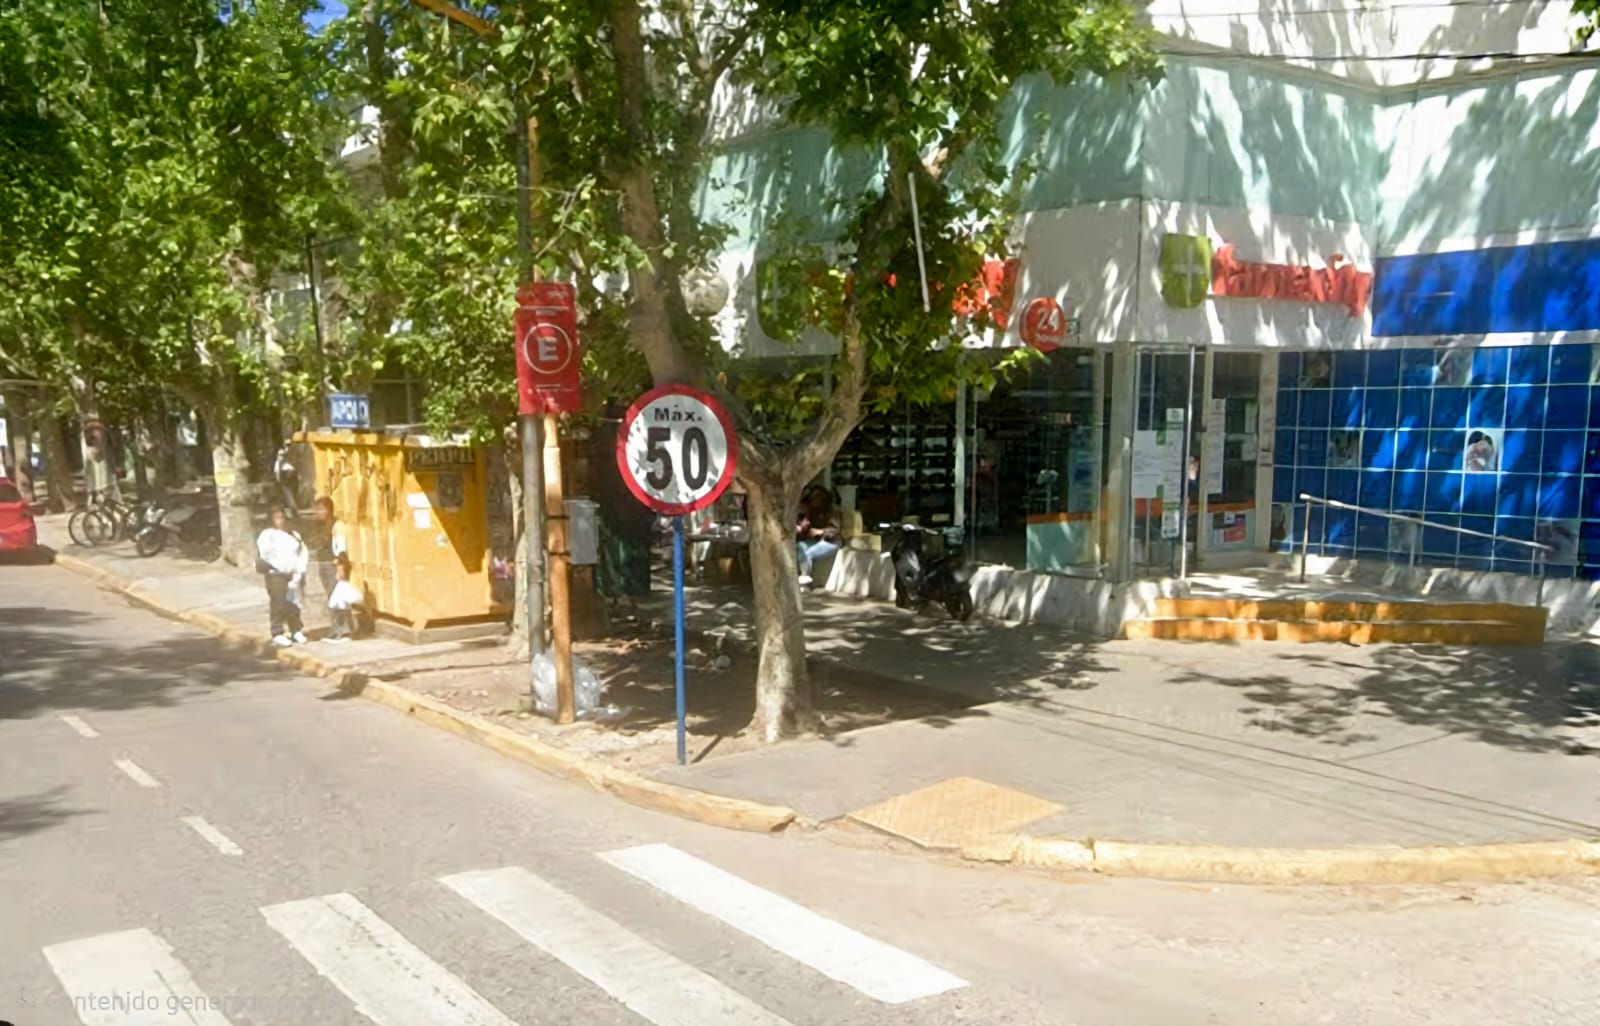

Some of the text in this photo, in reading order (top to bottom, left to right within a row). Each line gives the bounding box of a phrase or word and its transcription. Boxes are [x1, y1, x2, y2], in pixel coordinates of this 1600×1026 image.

[1036, 307, 1060, 331] 24
[536, 335, 559, 361] E
[646, 426, 708, 490] 50
